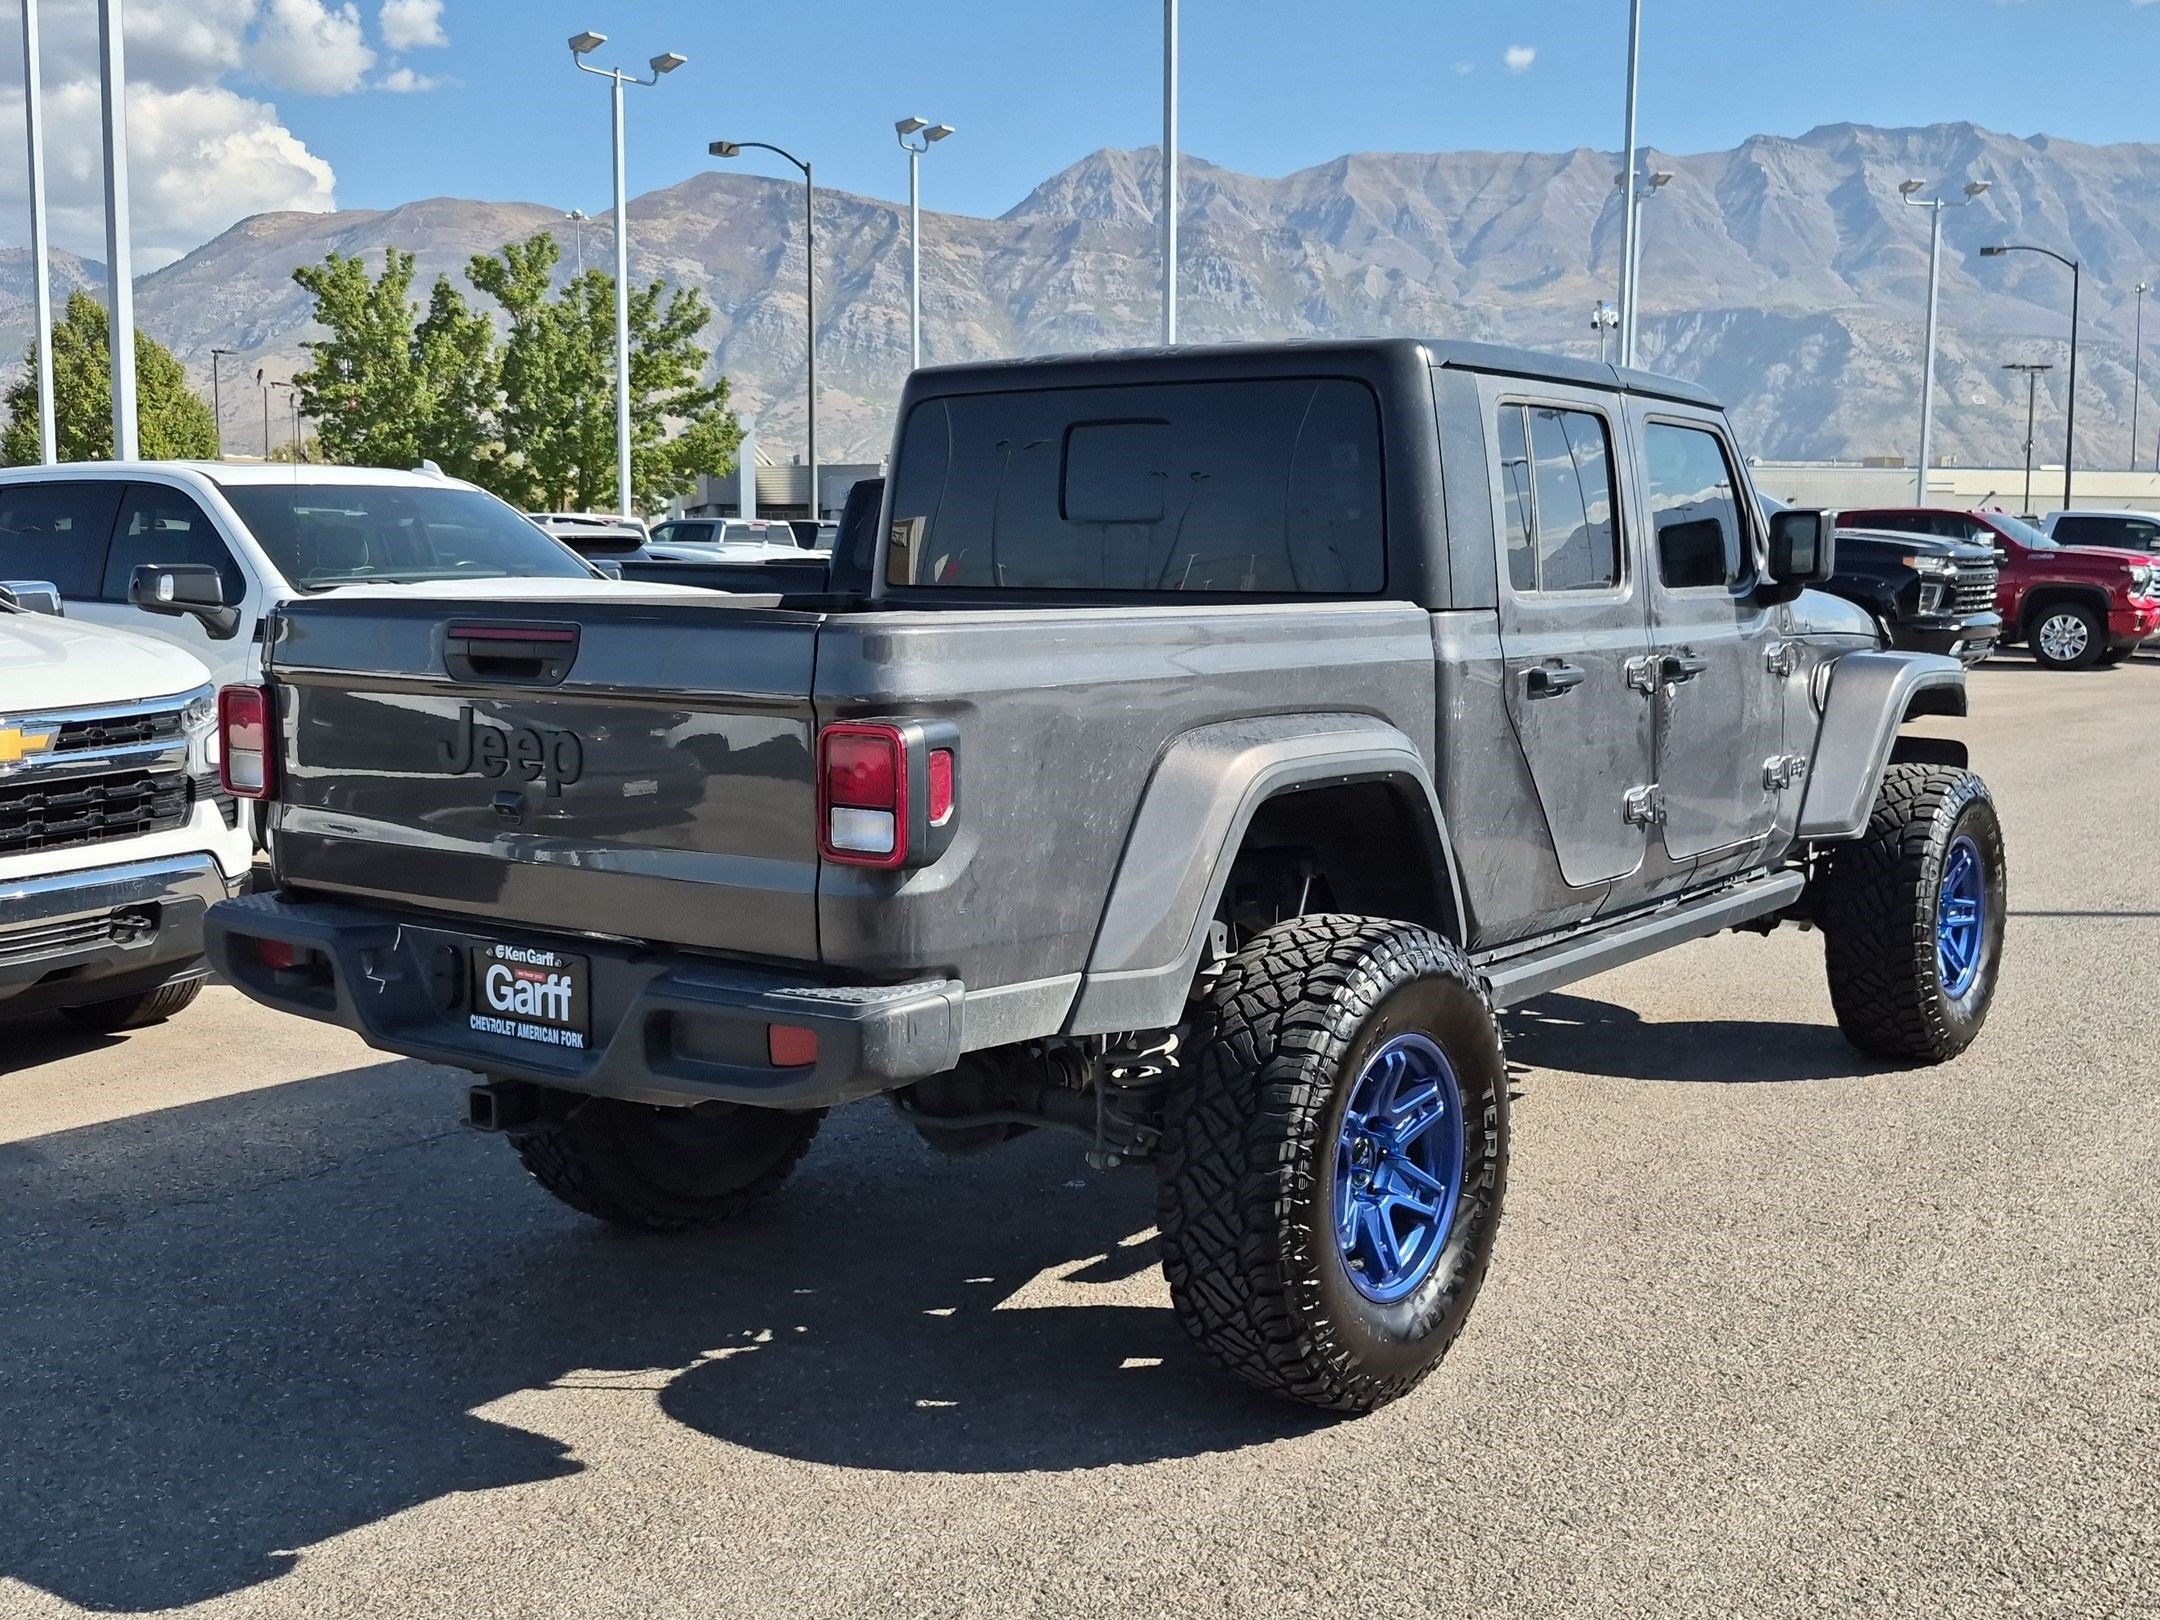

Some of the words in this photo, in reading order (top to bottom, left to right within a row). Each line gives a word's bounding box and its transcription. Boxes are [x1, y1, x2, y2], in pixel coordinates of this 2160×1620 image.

[437, 705, 583, 797] Jeep
[505, 945, 526, 963] Ken
[527, 948, 555, 967] Garff
[485, 964, 572, 1022] Garff
[470, 1013, 516, 1036] CHEVROLET
[517, 1022, 559, 1045] AMERICAN
[560, 1030, 584, 1049] FORK
